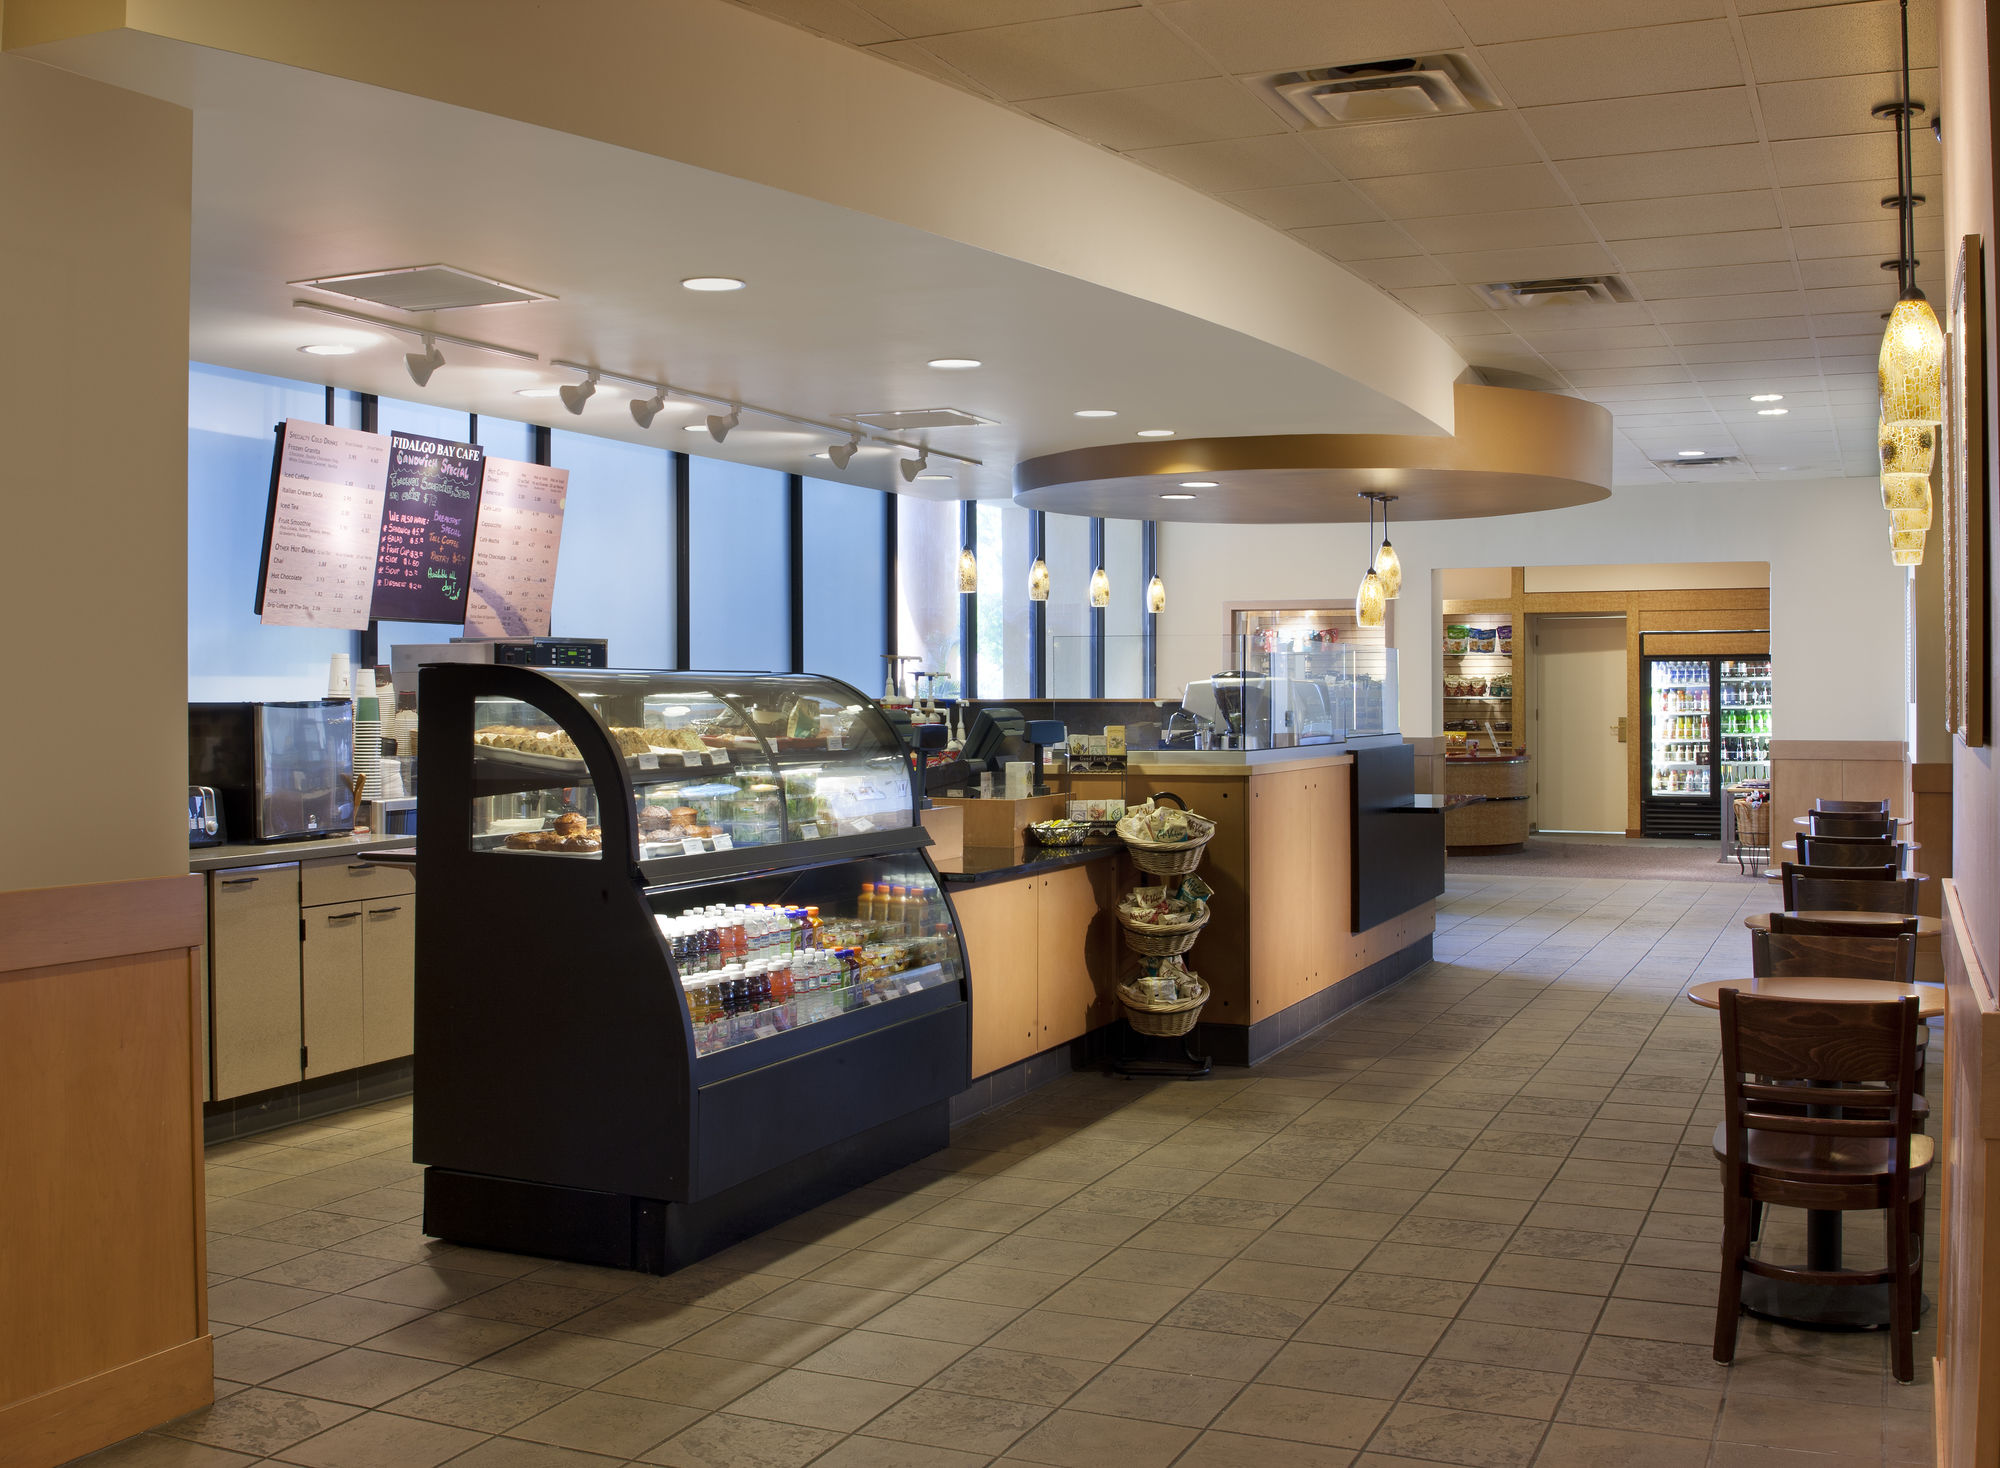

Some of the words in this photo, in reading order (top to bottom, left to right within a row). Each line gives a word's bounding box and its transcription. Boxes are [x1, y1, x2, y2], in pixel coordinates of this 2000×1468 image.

[288, 444, 303, 452] Frozen
[393, 436, 435, 454] FIDALGO
[437, 443, 456, 457] BAY
[456, 448, 480, 462] CAFE
[298, 489, 312, 497] Cream
[279, 517, 290, 525] Fruit
[291, 519, 311, 527] Smoothie
[389, 510, 400, 522] WE
[400, 515, 413, 524] ALSO
[387, 535, 403, 544] SALAD
[442, 536, 459, 548] COFFEE
[386, 544, 400, 555] FRUIT
[400, 546, 410, 557] CUP
[385, 556, 398, 564] SIDE
[430, 551, 450, 563] PASTRY
[385, 566, 400, 575] SOUP
[428, 567, 448, 580] Available
